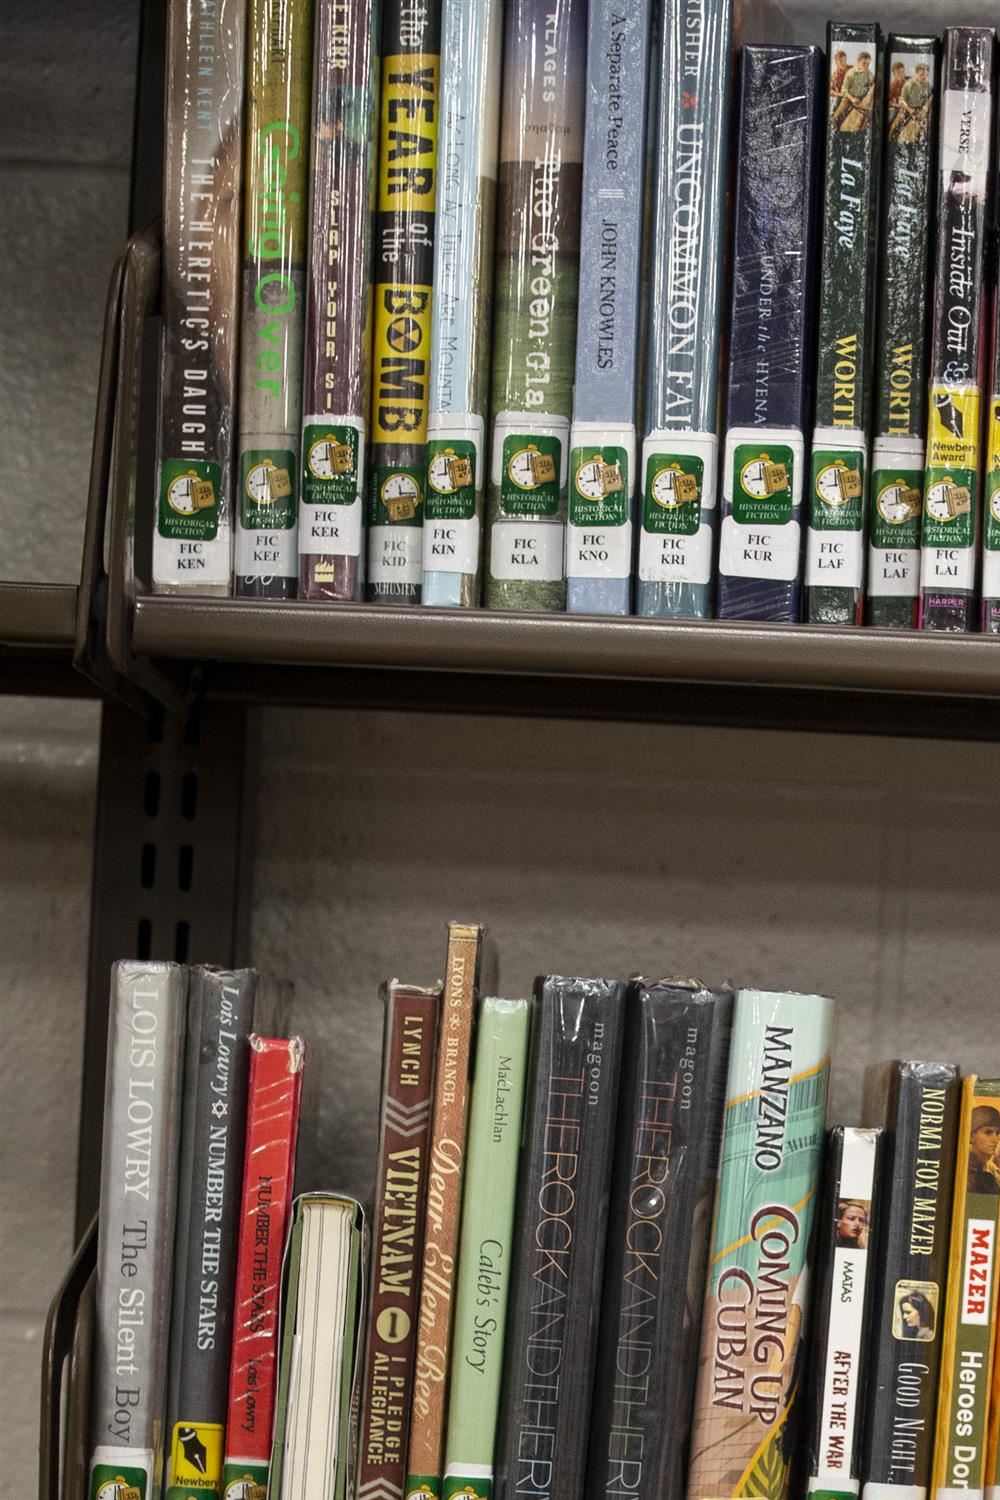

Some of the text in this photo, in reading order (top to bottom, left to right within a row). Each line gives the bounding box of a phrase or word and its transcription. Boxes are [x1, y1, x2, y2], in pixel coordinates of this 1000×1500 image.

[543, 13, 557, 103] KLAGES
[607, 13, 626, 170] A Separate Peace
[387, 66, 435, 197] YEAR
[959, 108, 973, 155] VERSE
[184, 157, 214, 352] THE HERETIC'S
[836, 156, 863, 249] La Faye
[597, 218, 617, 370] JOHN KNOWLES
[946, 223, 975, 368] Inside Out
[933, 443, 976, 454] Newbery
[933, 452, 966, 462] Award
[176, 558, 206, 569] KEN
[180, 543, 203, 555] FIC
[739, 503, 790, 512] HISTORICAL
[743, 549, 773, 561] KUR
[745, 511, 781, 520] FICTION
[747, 535, 771, 547] FIC
[123, 990, 156, 1202] LOIS LOWRY
[207, 987, 239, 1099] Lois Lowry
[401, 1015, 423, 1087] LYNCH
[493, 1054, 513, 1144] MacLachlan
[753, 1024, 795, 1173] MANZANO
[379, 1148, 419, 1293] VIETNAM
[909, 1087, 945, 1256] NORMA FOX MAZER
[197, 1127, 227, 1349] NUMBER THE STARS
[966, 1227, 989, 1316] MAZER
[111, 1220, 148, 1444] The Silent Boy
[466, 1238, 505, 1375] Caleb's Story
[714, 1269, 753, 1413] CUBAN
[748, 1205, 800, 1425] COMING UP
[367, 1352, 388, 1465] ALLEGIANCE
[384, 1373, 404, 1464] PLEDGE
[827, 1350, 850, 1470] AFTER THE WAR
